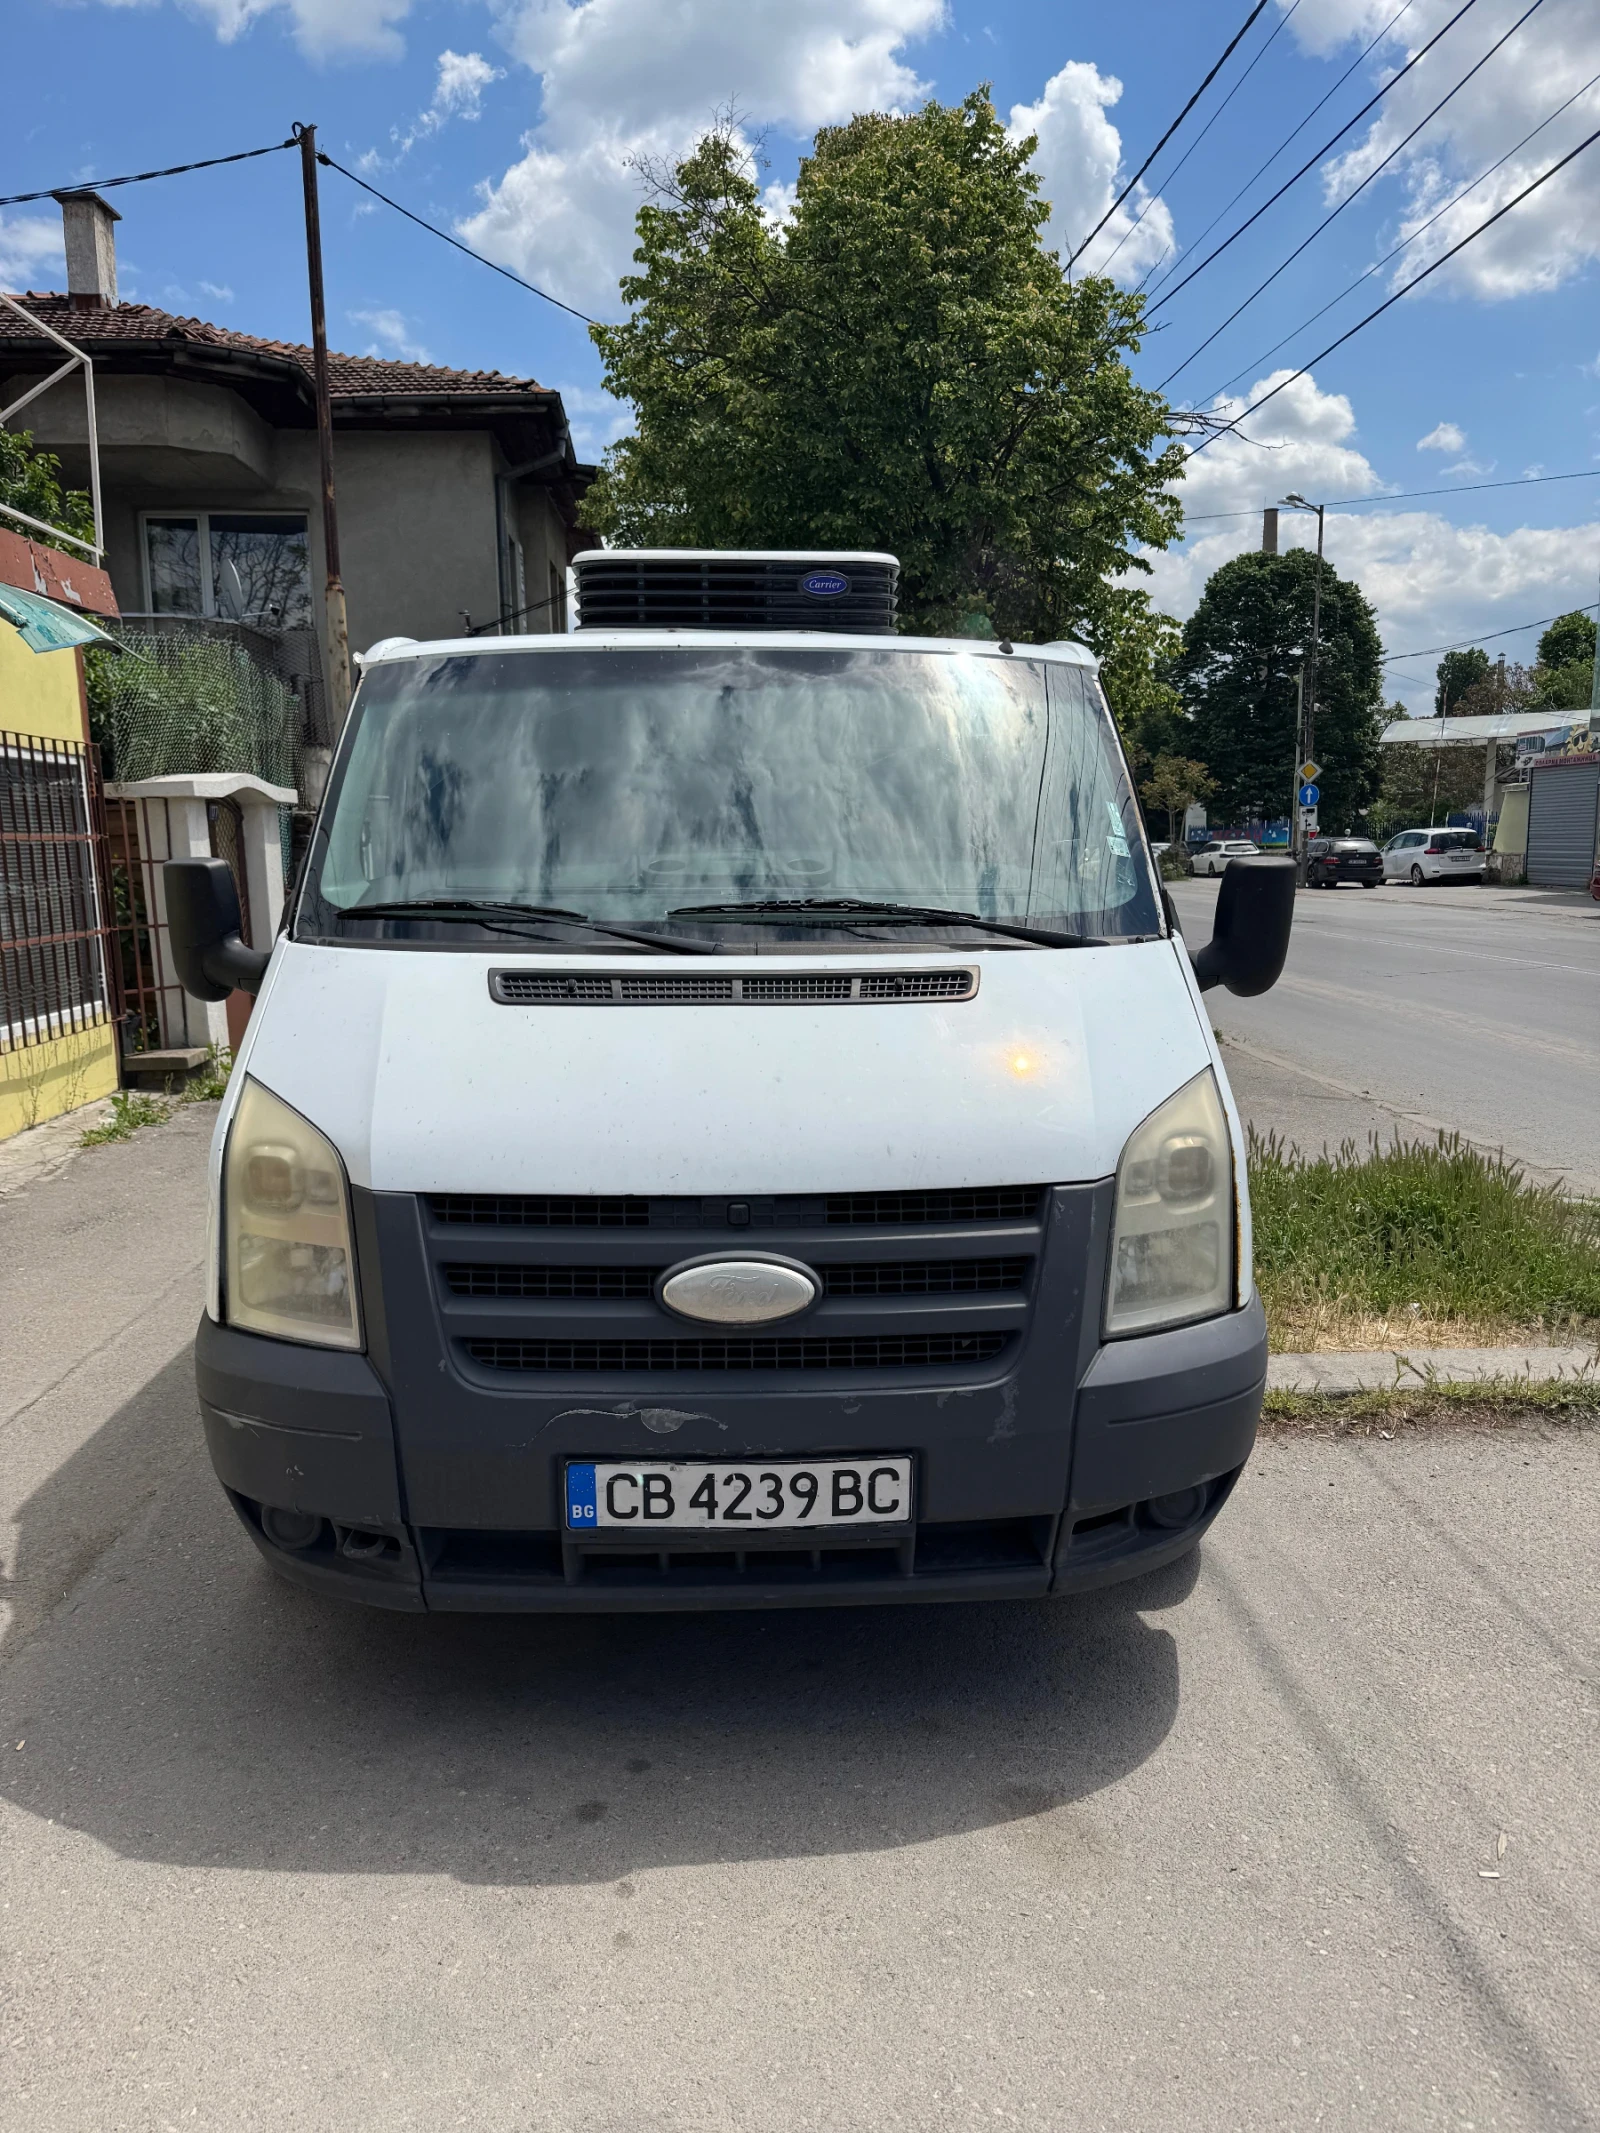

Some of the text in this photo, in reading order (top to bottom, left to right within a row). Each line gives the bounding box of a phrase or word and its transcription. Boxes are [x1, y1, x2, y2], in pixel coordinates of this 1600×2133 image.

[808, 579, 842, 589] Carrier
[702, 1274, 780, 1308] Ford
[606, 1467, 900, 1521] CB 4239 BC
[571, 1504, 595, 1519] BG
